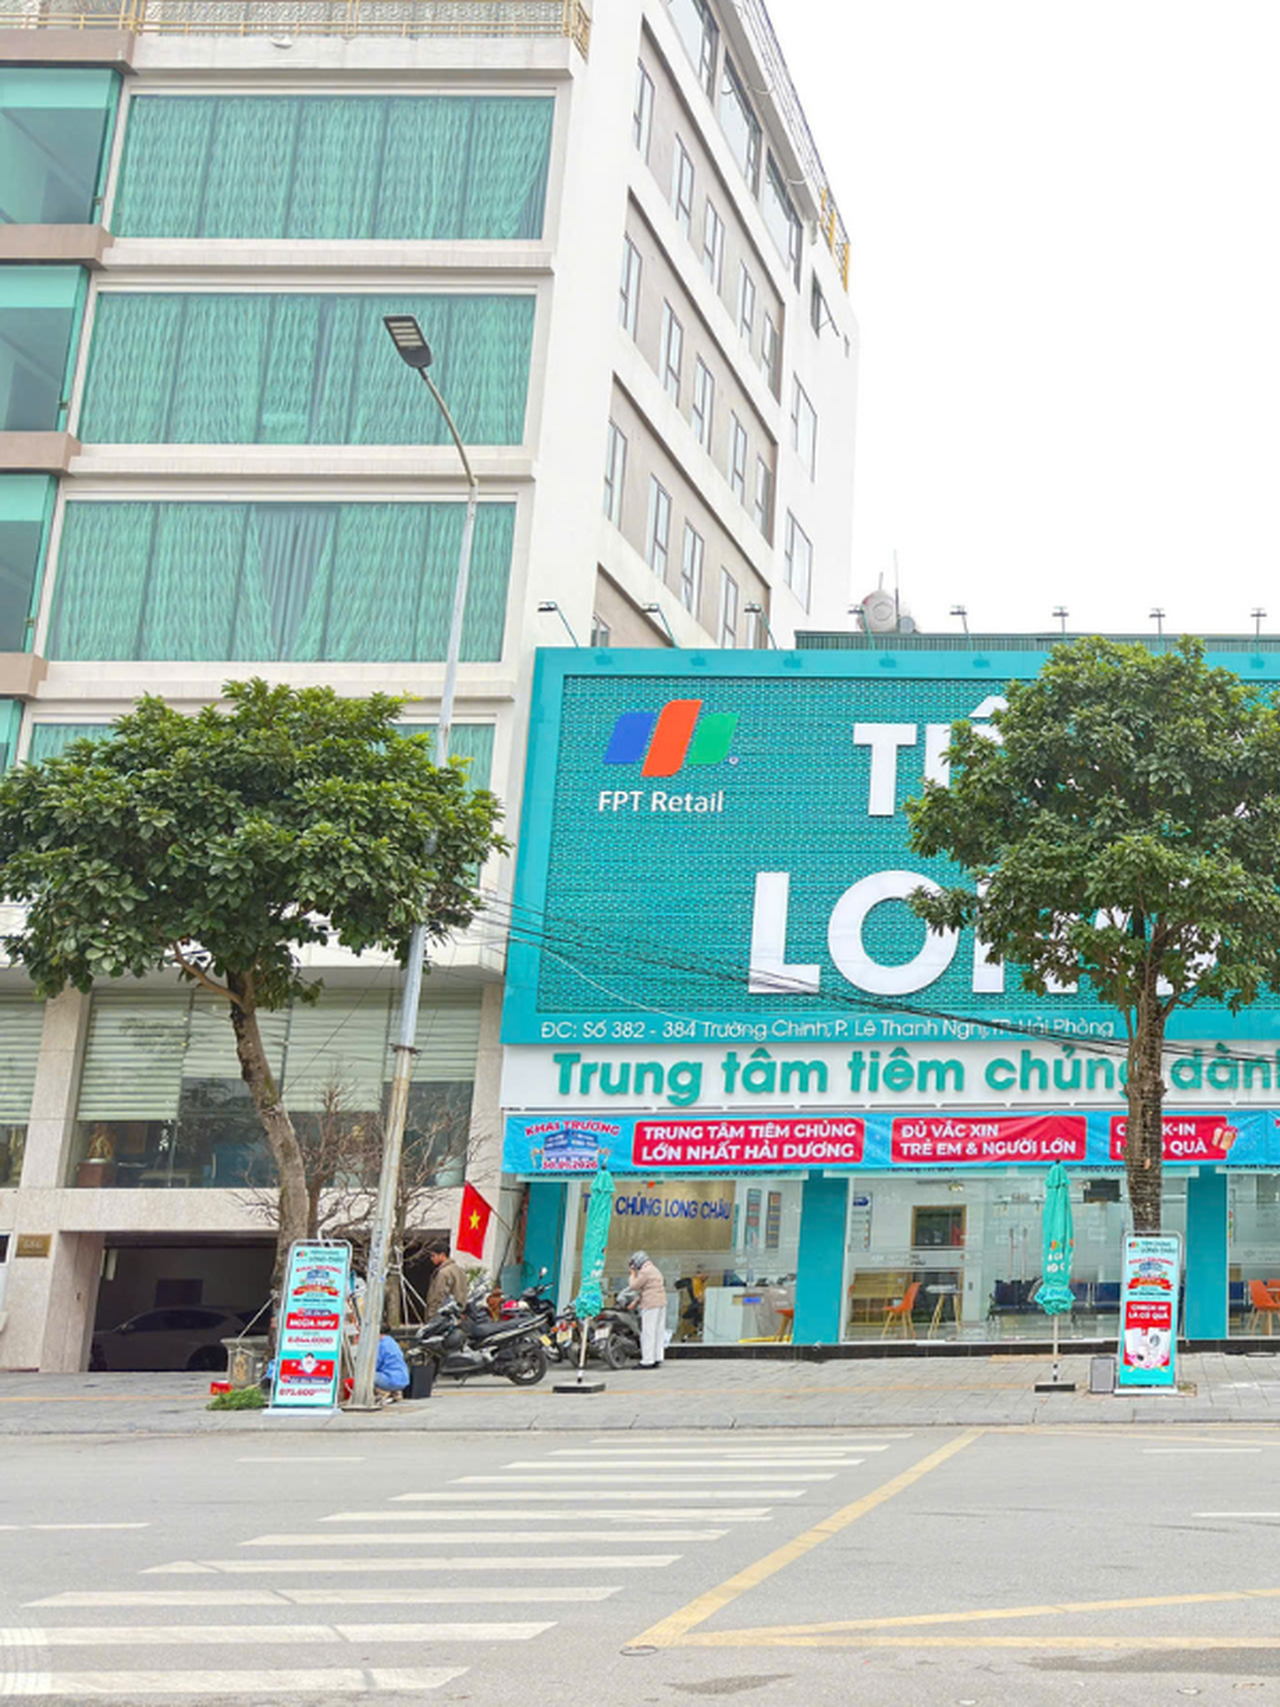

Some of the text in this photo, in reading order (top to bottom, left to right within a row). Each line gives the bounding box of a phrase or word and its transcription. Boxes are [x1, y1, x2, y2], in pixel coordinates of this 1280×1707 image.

[599, 790, 724, 813] FPT Retail
[541, 1021, 577, 1039] ĐC:
[583, 1020, 606, 1038] Số
[611, 1021, 645, 1038] 382
[663, 1021, 696, 1038] 384
[703, 1020, 766, 1041] Trường
[836, 1019, 848, 1037] P.
[855, 1019, 877, 1037] Lê
[881, 1019, 940, 1037] Thanh
[554, 1051, 704, 1105] Trung
[723, 1047, 830, 1094] tâm
[849, 1046, 965, 1092] tiêm
[524, 1122, 561, 1137] KHAI
[643, 1120, 857, 1141] TRUNG TÂM TIÊM CHỦNG
[901, 1120, 926, 1138] ĐỦ
[970, 1123, 999, 1138] XIN
[642, 1140, 857, 1162] LỚN NHẤT HẢI DƯƠNG
[900, 1138, 1077, 1156] TRẺ EM & NGƯỜI LỚN
[1170, 1136, 1208, 1157] QUÀ
[665, 1198, 700, 1219] LONG
